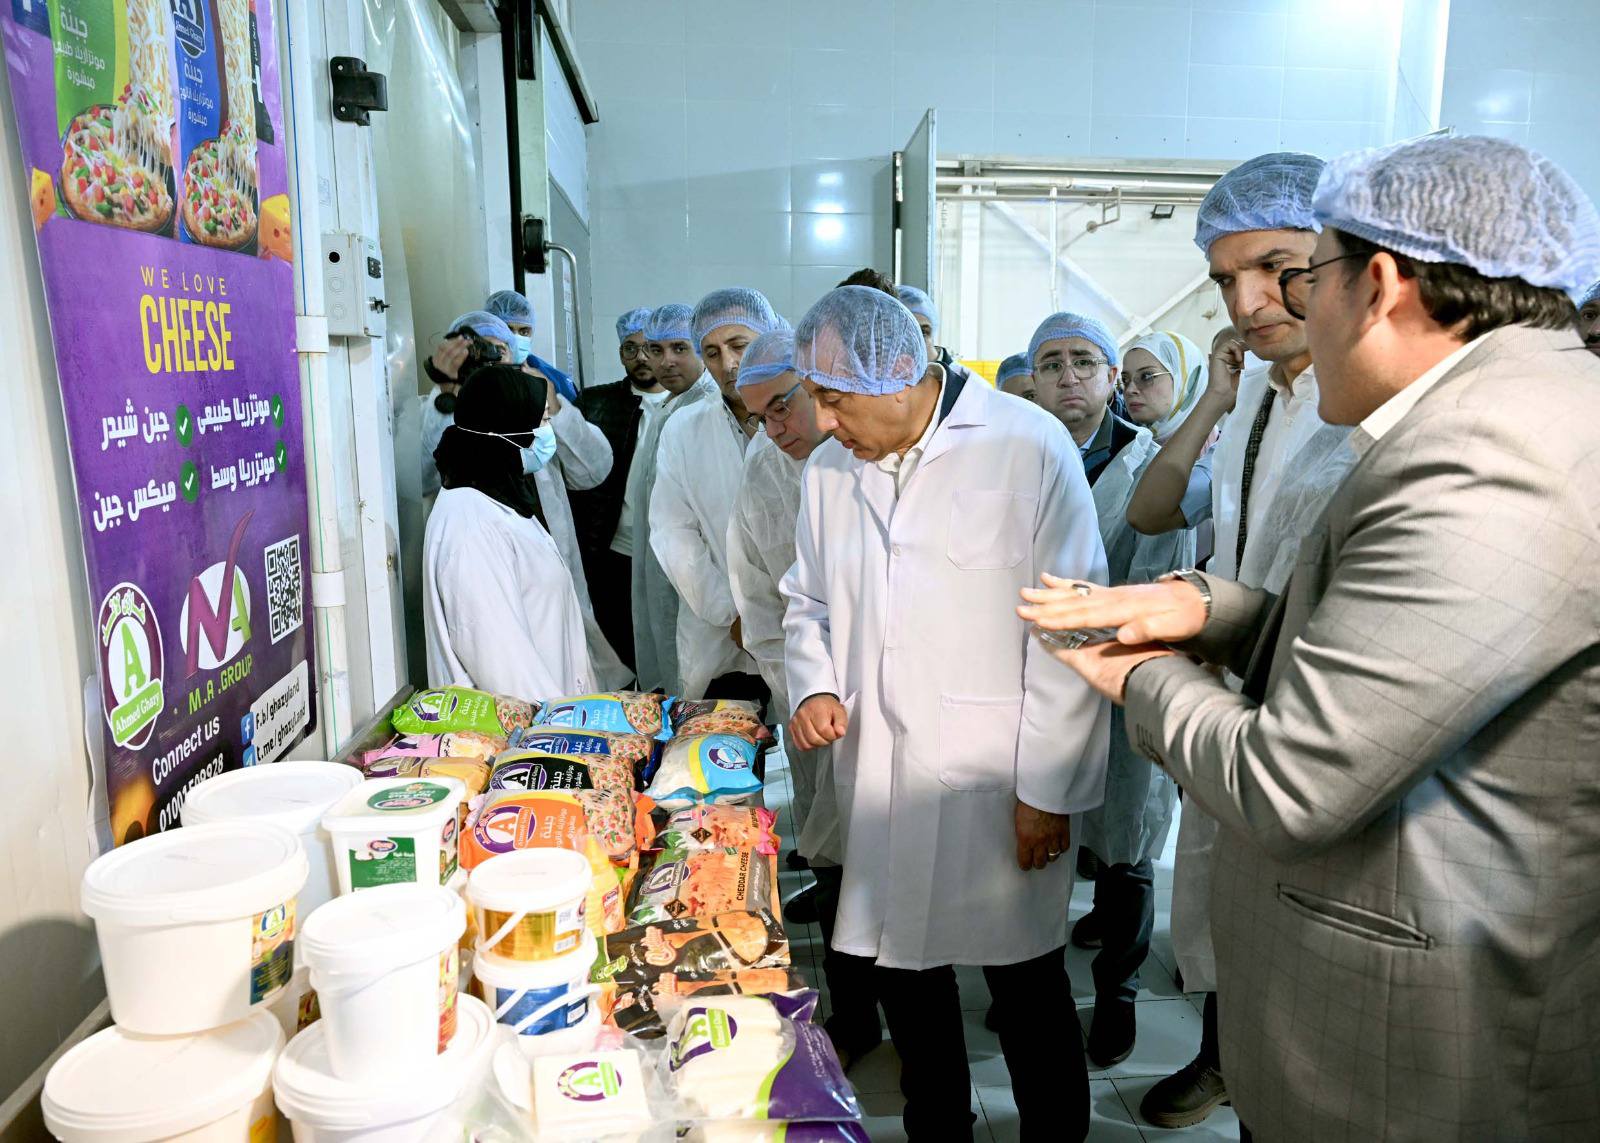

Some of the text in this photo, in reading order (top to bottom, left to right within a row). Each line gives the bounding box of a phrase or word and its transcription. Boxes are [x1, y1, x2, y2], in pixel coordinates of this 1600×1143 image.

[140, 264, 228, 296] WE LOVE
[139, 294, 235, 374] CHEESE
[101, 398, 170, 452] جبن شيدر
[210, 464, 238, 492] وسط
[92, 478, 177, 533] ميكس جبن
[121, 622, 147, 699] A
[115, 693, 161, 735] Ahmed Ghazy
[152, 716, 220, 786] Connect us
[488, 815, 516, 836] A
[736, 852, 749, 901] CHEDDAR CHEESE
